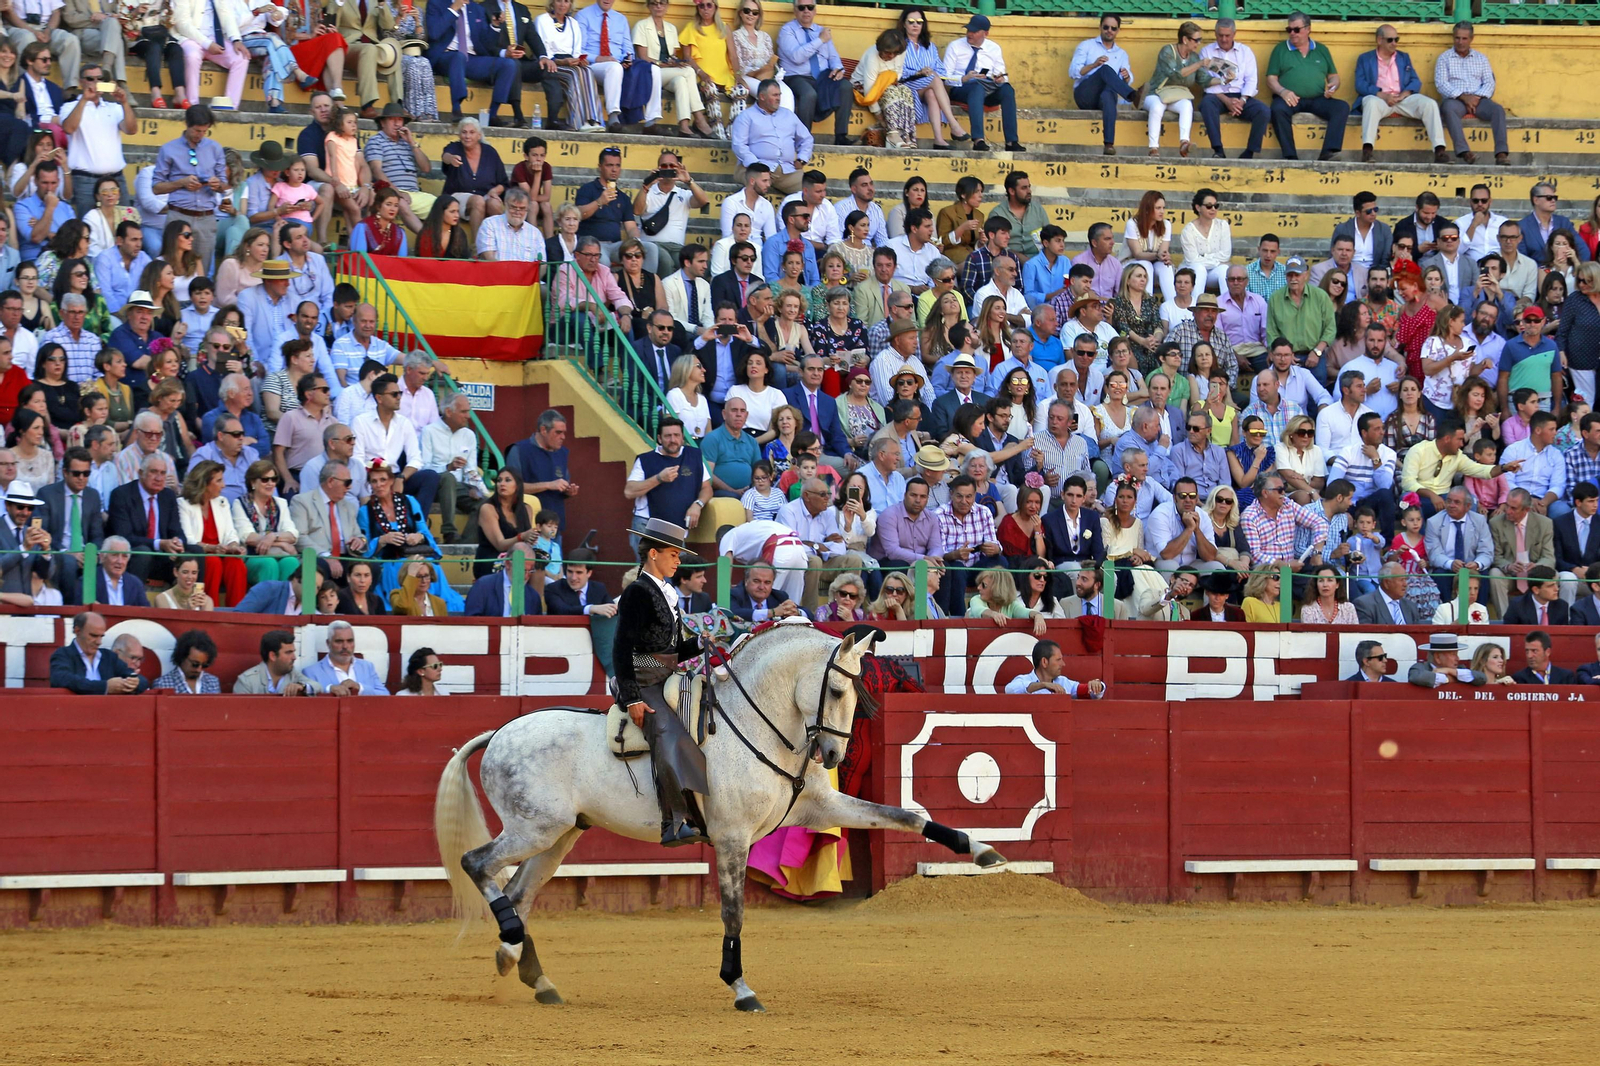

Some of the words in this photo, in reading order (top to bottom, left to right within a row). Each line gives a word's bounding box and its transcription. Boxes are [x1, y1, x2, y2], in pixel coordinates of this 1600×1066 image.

[142, 120, 158, 135] 12
[250, 126, 266, 141] 14
[1468, 130, 1488, 143] 40
[1522, 130, 1540, 144] 41
[1575, 131, 1595, 144] 42
[560, 143, 579, 156] 20
[903, 157, 923, 172] 27
[1045, 163, 1067, 177] 30
[1100, 165, 1120, 178] 31
[1155, 166, 1177, 180] 32
[1055, 208, 1075, 221] 29
[461, 384, 491, 397] SALIDA
[1474, 691, 1495, 701] DEL
[1506, 692, 1559, 701] GOBIERNO
